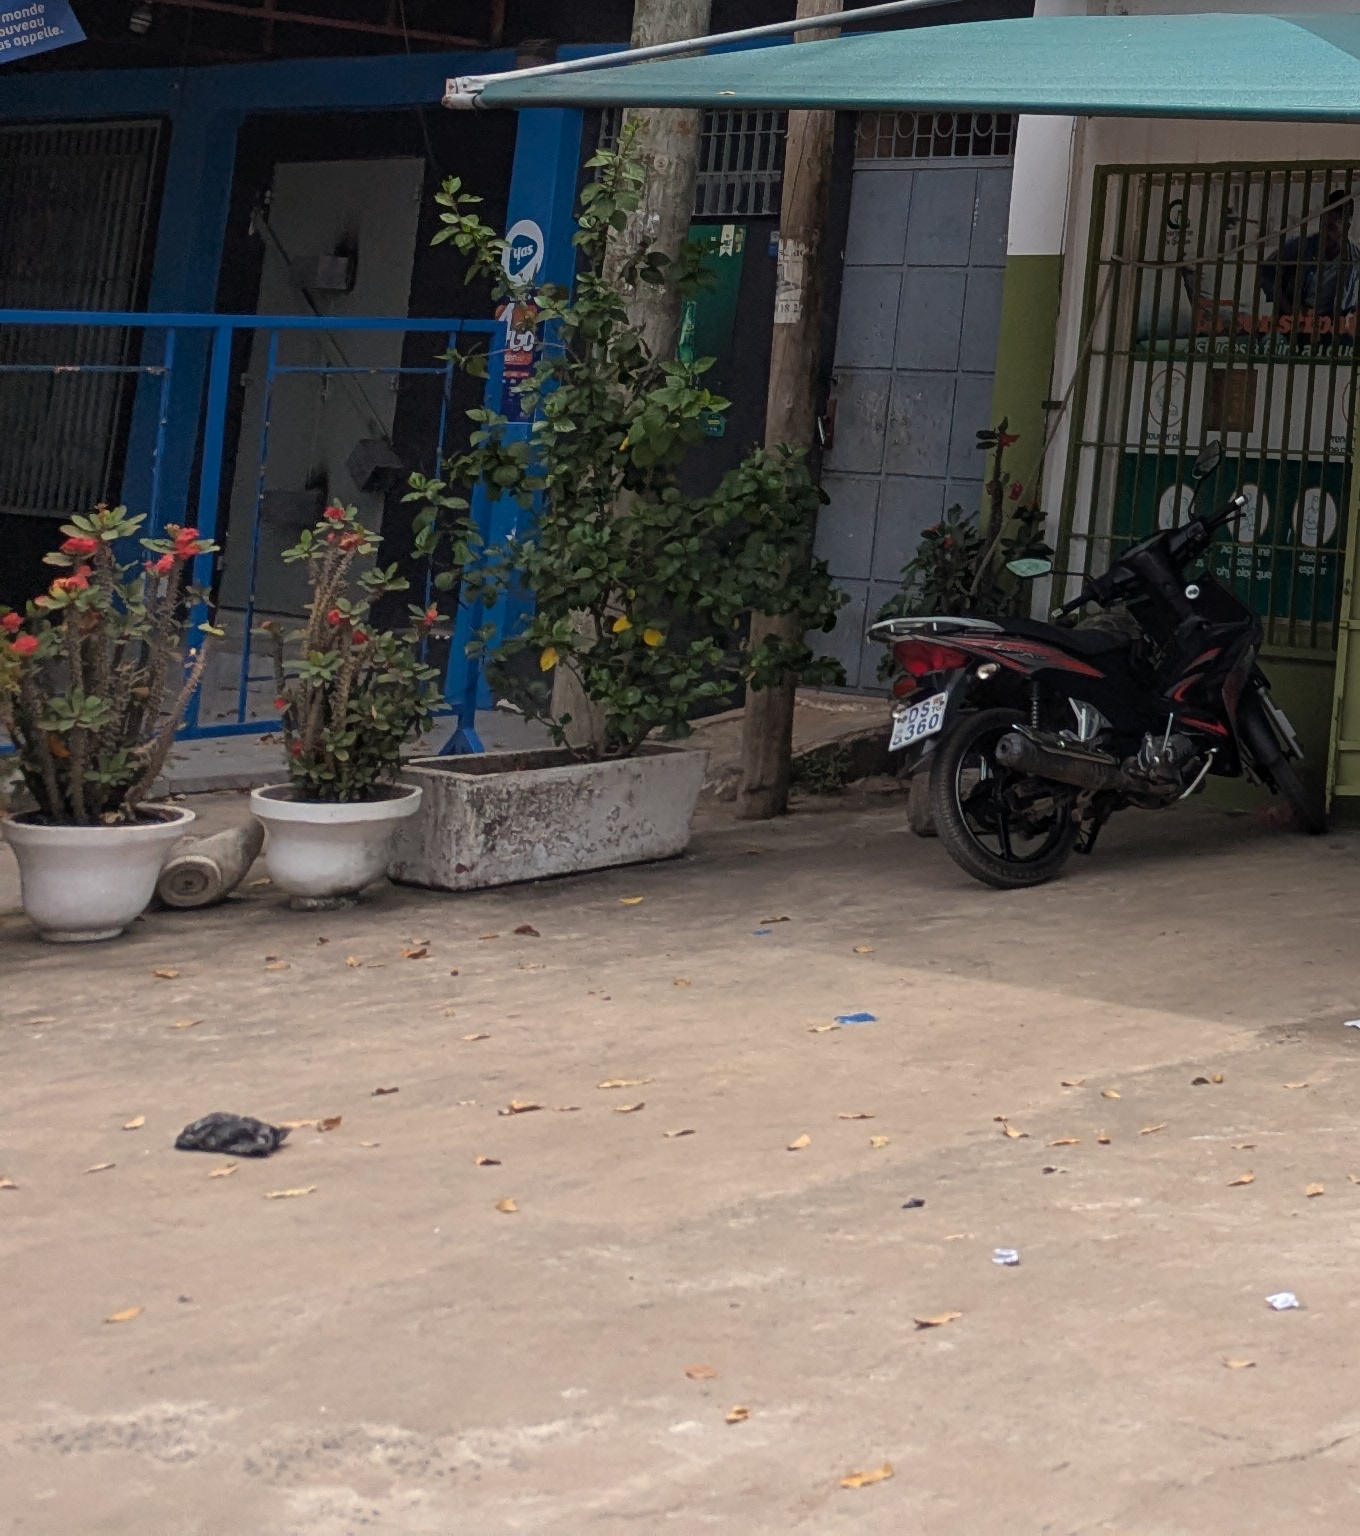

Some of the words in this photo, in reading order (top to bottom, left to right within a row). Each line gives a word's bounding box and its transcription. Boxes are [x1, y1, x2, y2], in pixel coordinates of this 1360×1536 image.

[2, 3, 45, 23] monde
[0, 17, 45, 38] ouveau
[14, 26, 64, 47] appelle.
[513, 244, 534, 265] yas
[908, 701, 931, 724] DS
